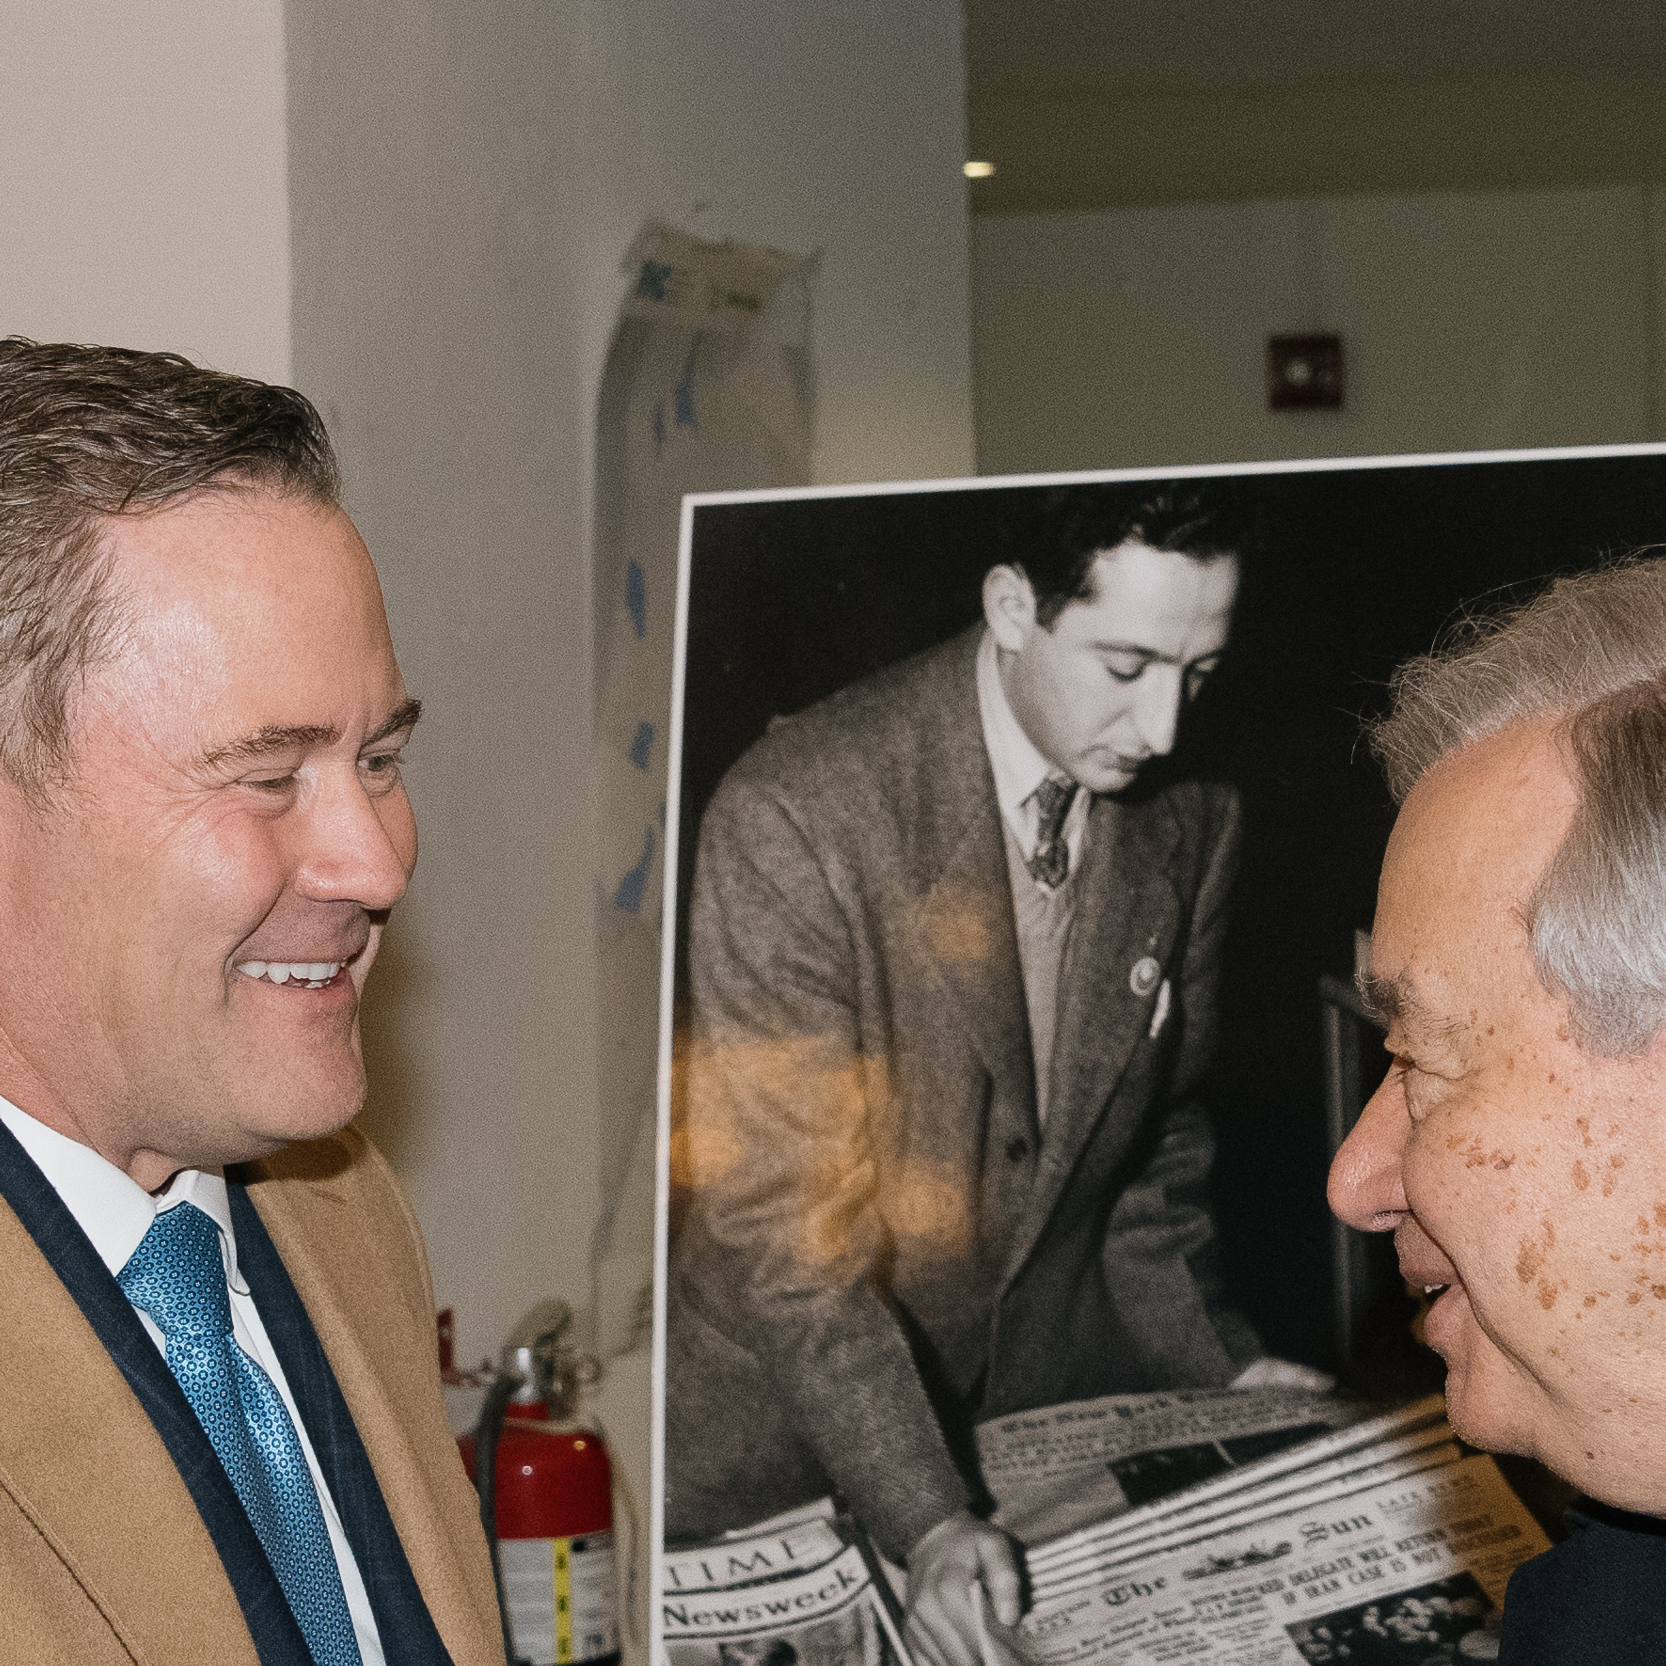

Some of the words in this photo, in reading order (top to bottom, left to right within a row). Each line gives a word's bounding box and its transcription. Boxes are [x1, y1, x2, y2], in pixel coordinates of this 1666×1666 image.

[664, 1530, 815, 1588] TIME
[1101, 1575, 1167, 1607] The
[1298, 1513, 1375, 1548] Sun
[1348, 1564, 1385, 1586] CASE
[664, 1567, 857, 1627] Newsweek
